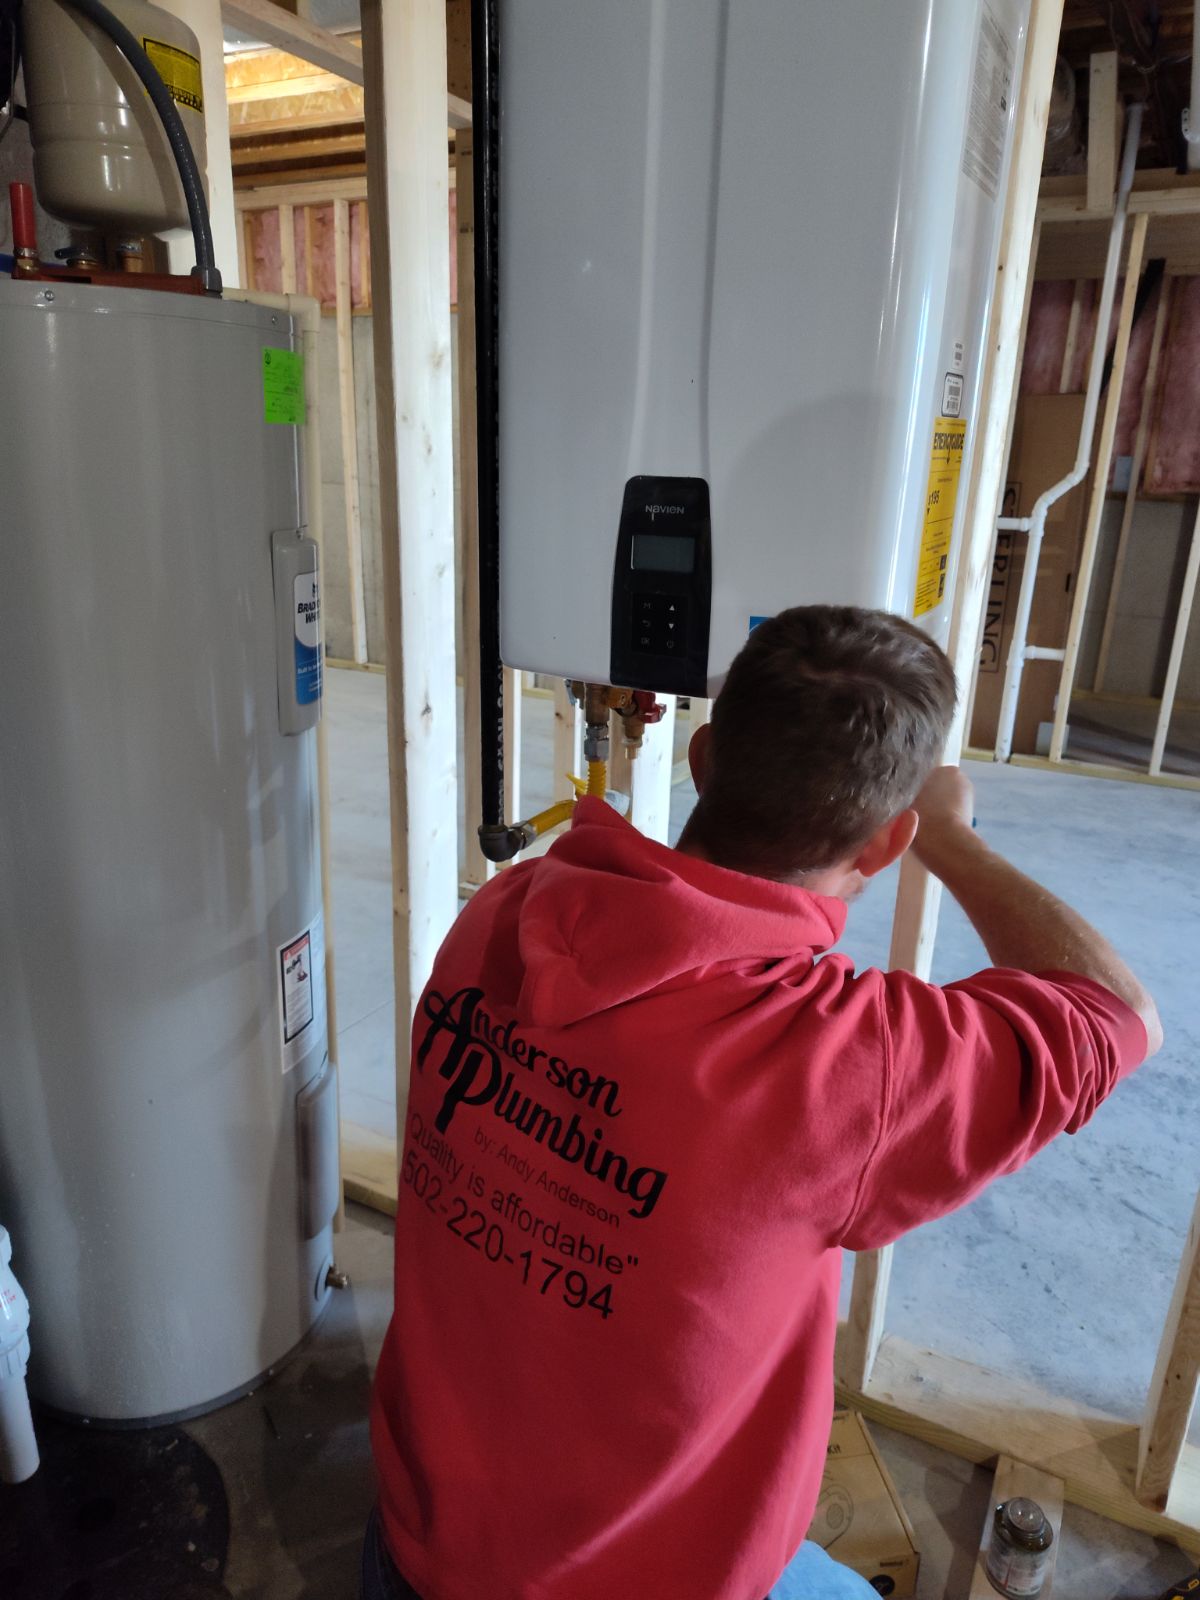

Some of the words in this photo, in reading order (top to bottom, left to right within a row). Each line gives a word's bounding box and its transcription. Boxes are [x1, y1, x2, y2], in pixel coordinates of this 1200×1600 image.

[417, 987, 622, 1117] Anderson
[434, 1039, 668, 1219] Plumbing
[473, 1126, 498, 1154] by:
[499, 1140, 535, 1183] Andy
[536, 1170, 620, 1228] Anderson
[403, 1151, 615, 1320] 502-220-1794
[469, 1166, 486, 1198] is
[491, 1188, 639, 1275] affordable"
